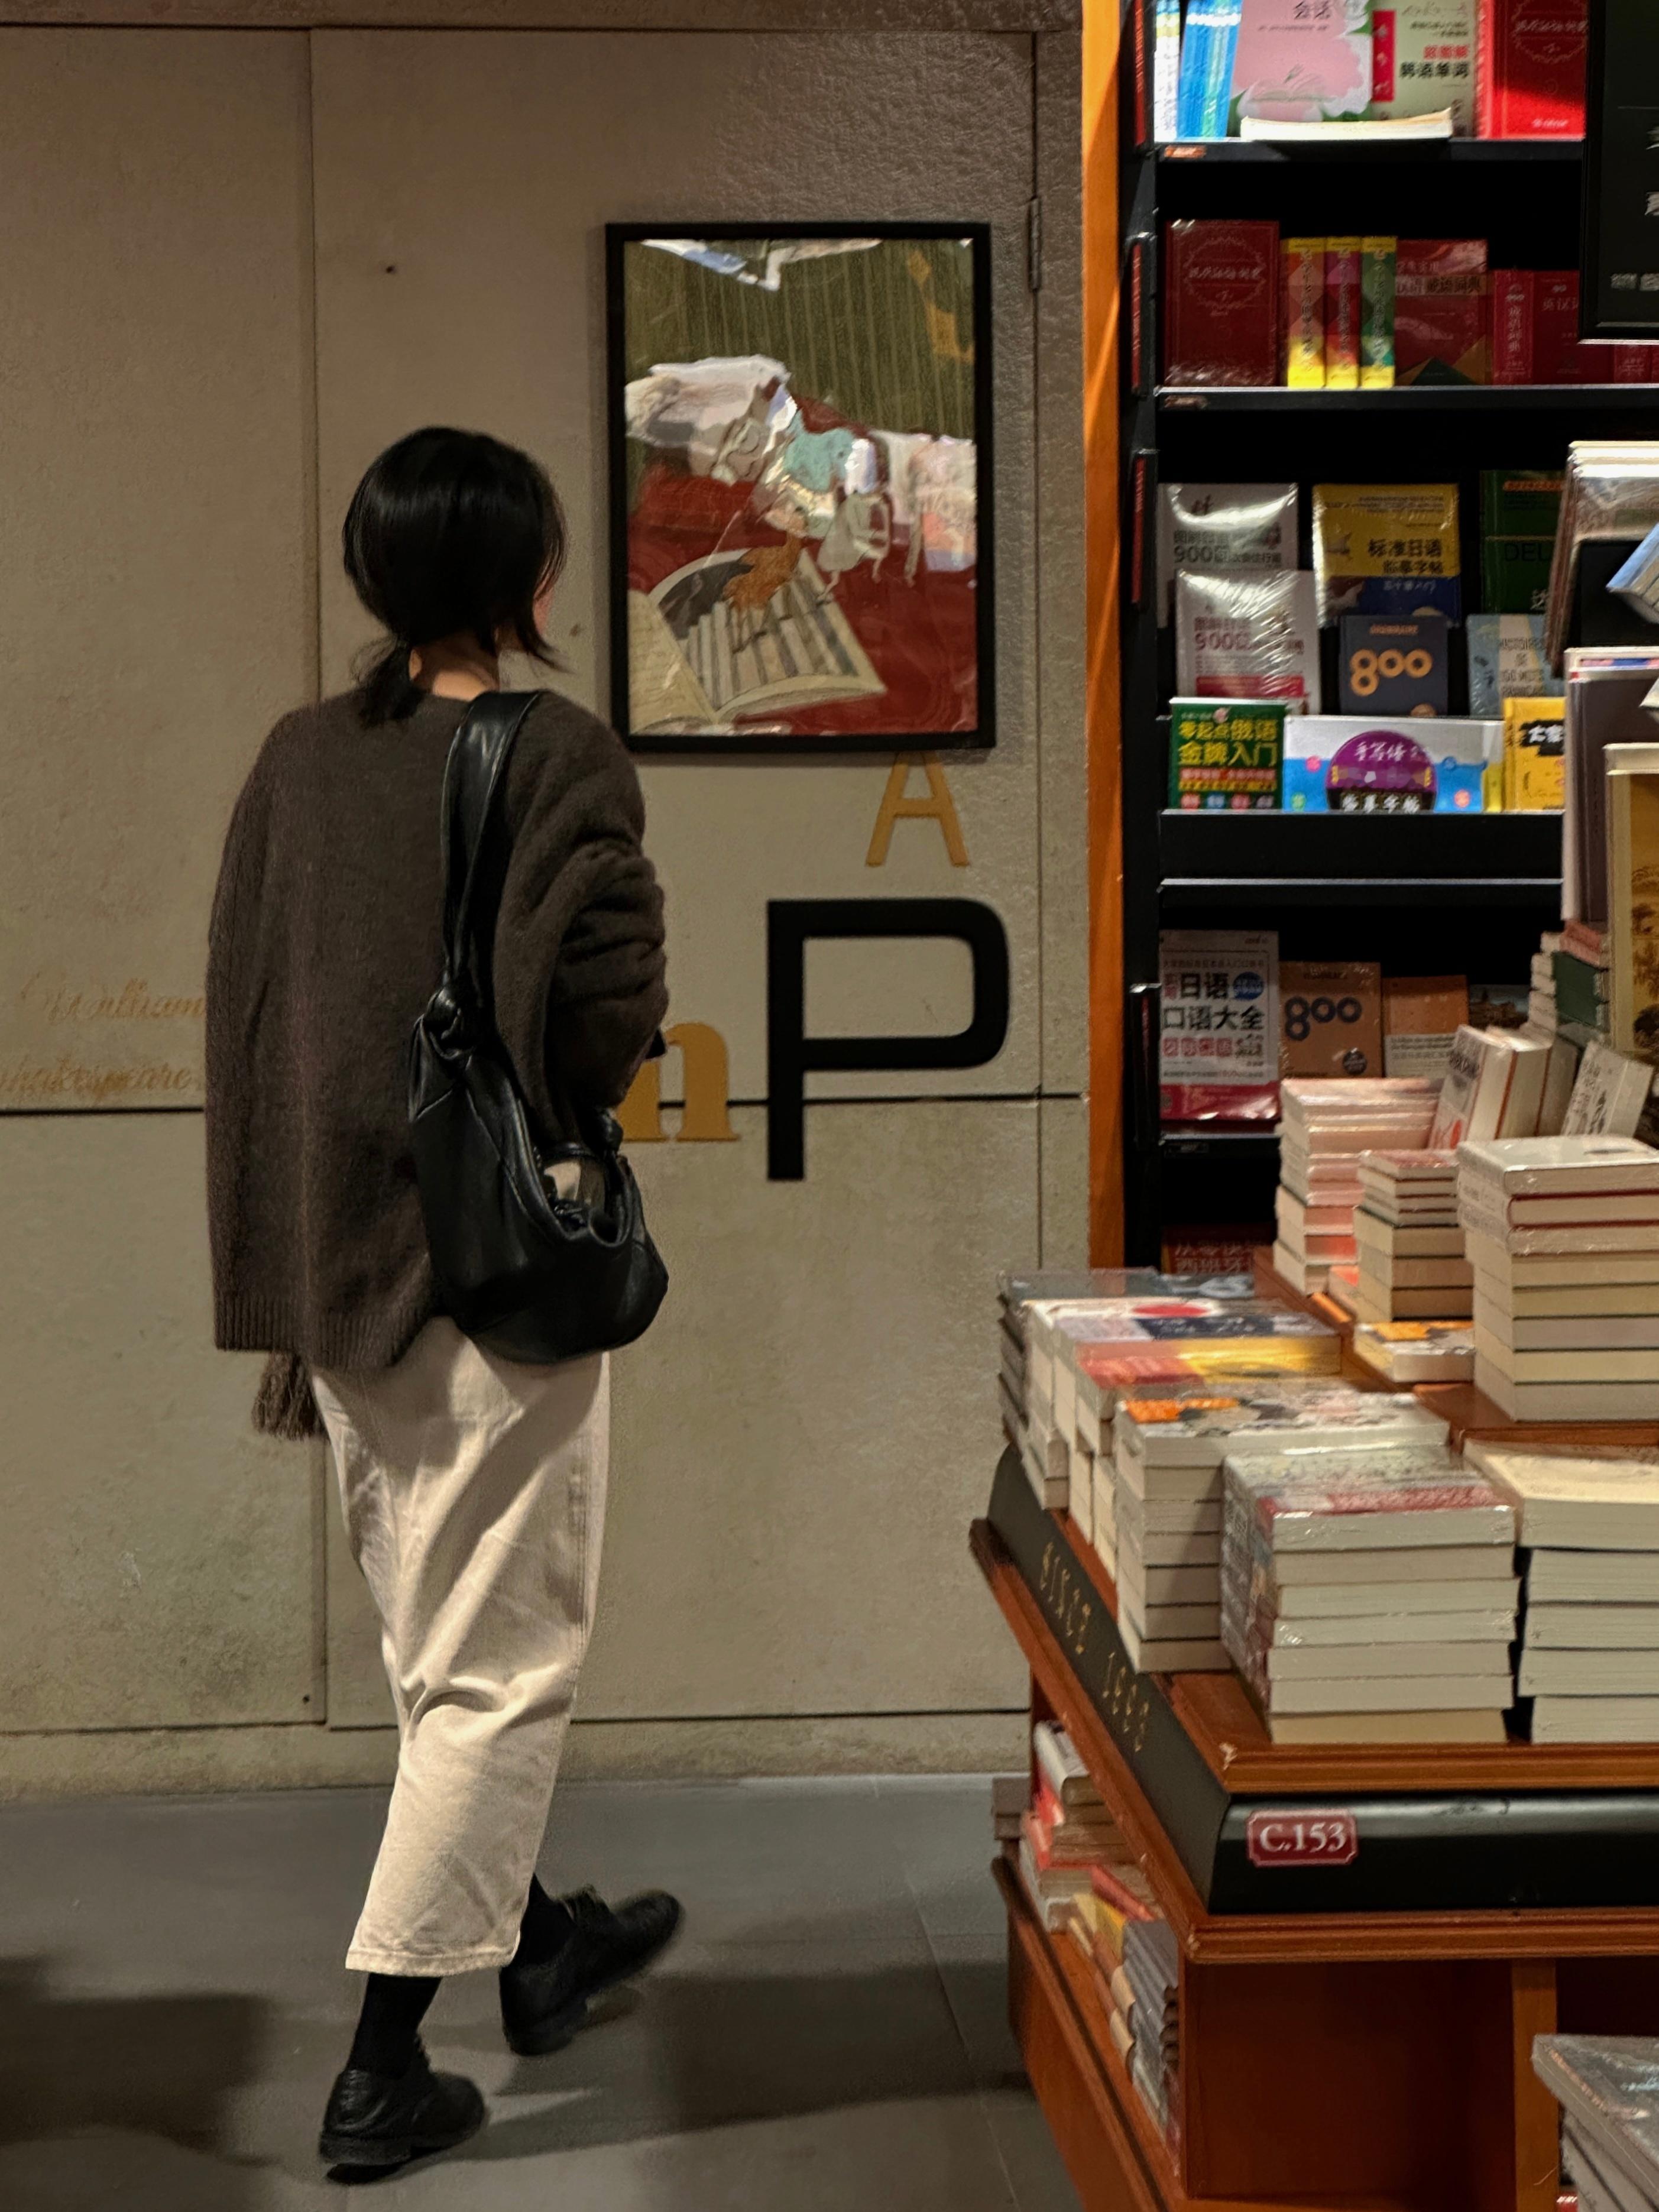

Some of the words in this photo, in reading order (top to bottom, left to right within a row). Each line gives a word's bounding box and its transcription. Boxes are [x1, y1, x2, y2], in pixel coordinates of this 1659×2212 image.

[1368, 539, 1443, 558] 标准日语
[1349, 649, 1433, 697] 800
[1178, 741, 1278, 766] 金牌入门
[866, 751, 970, 867] A
[1181, 973, 1229, 1000] 日语
[1163, 1005, 1265, 1031] 口语大全
[1285, 996, 1362, 1041] 800
[767, 898, 1009, 1181] P
[1259, 1822, 1347, 1852] C.153
